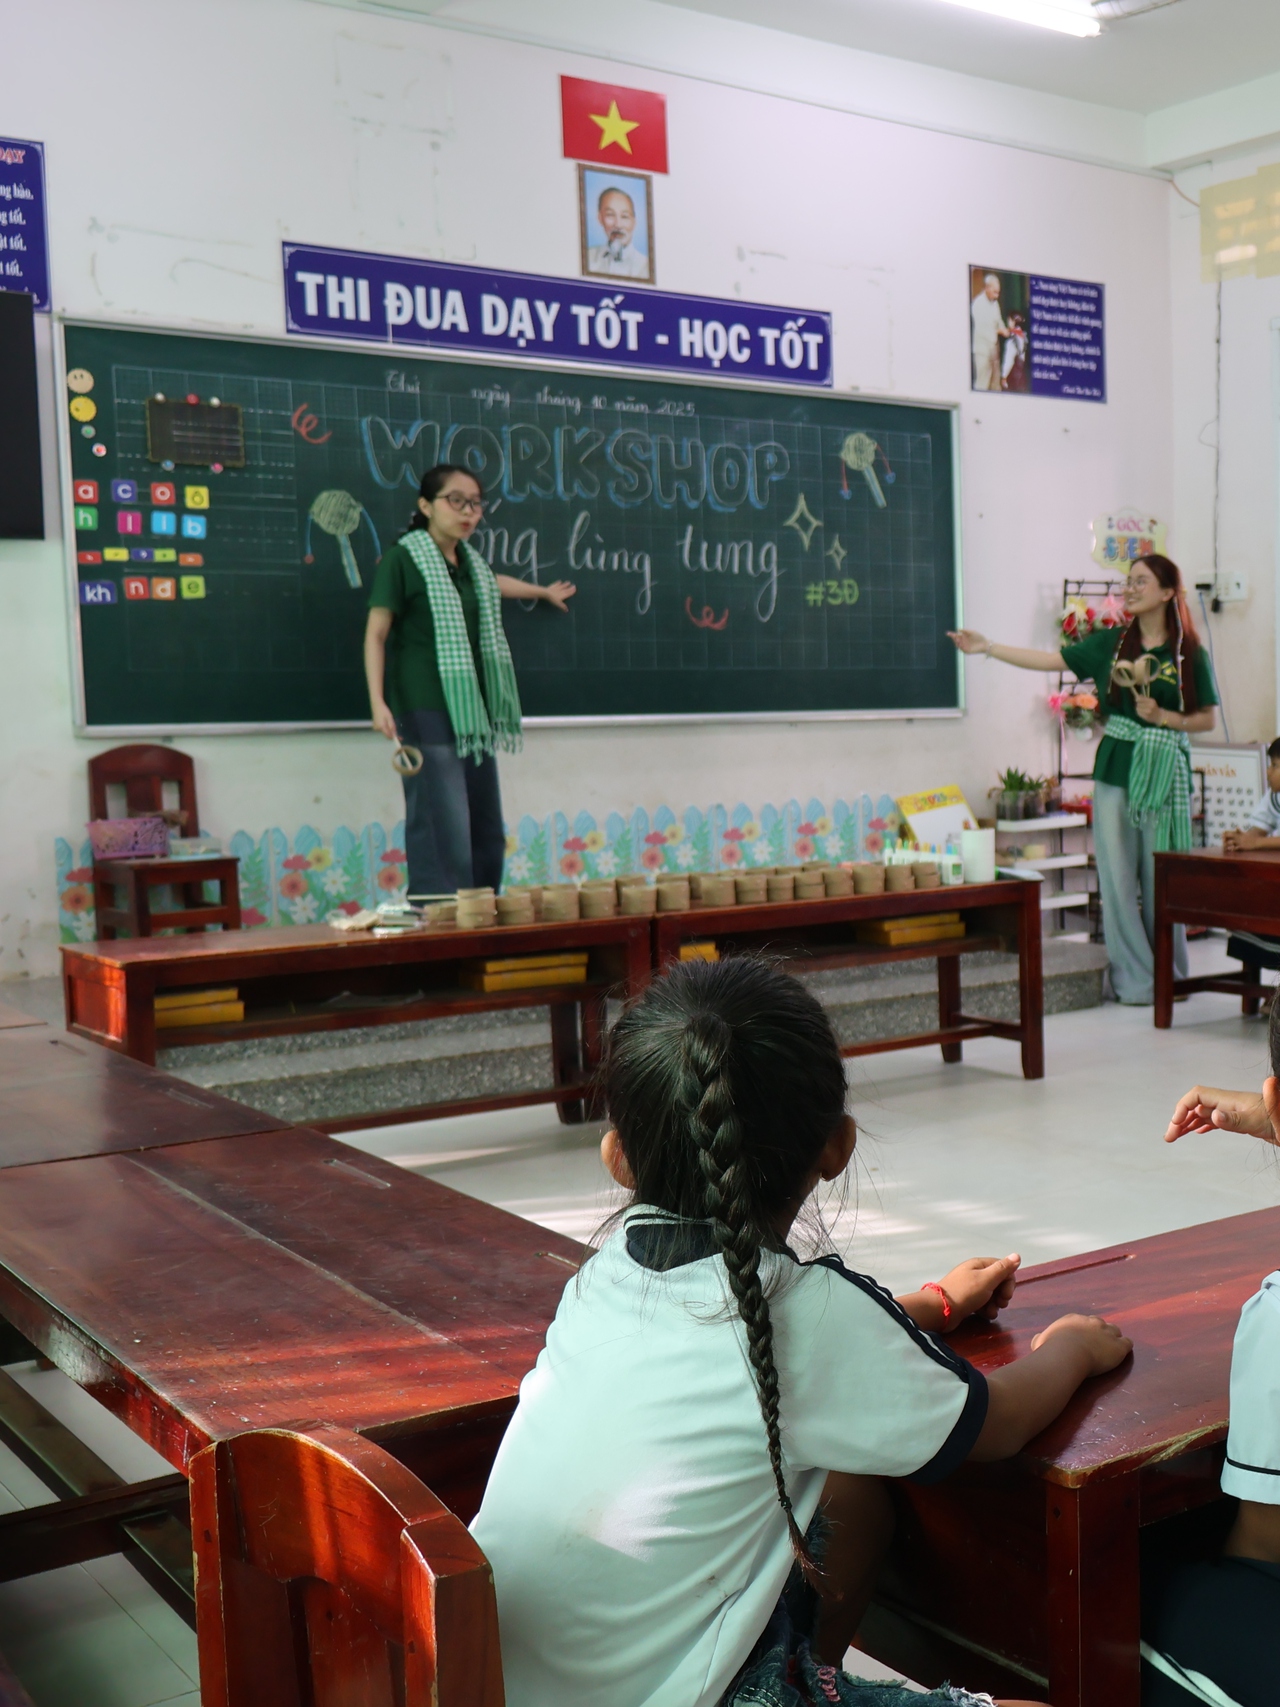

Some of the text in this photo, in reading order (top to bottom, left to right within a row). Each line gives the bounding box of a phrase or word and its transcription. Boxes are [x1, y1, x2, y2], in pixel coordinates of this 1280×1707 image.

[296, 272, 824, 371] THI ĐUA DẠY TỐT - HỌC TỐT
[656, 400, 696, 416] 2025
[361, 415, 790, 513] WORKSHOP
[117, 484, 133, 499] c
[155, 486, 171, 501] o
[78, 509, 93, 527] h
[188, 518, 202, 536] b
[1105, 536, 1155, 562] STEM
[84, 583, 111, 602] kh
[129, 581, 144, 595] n
